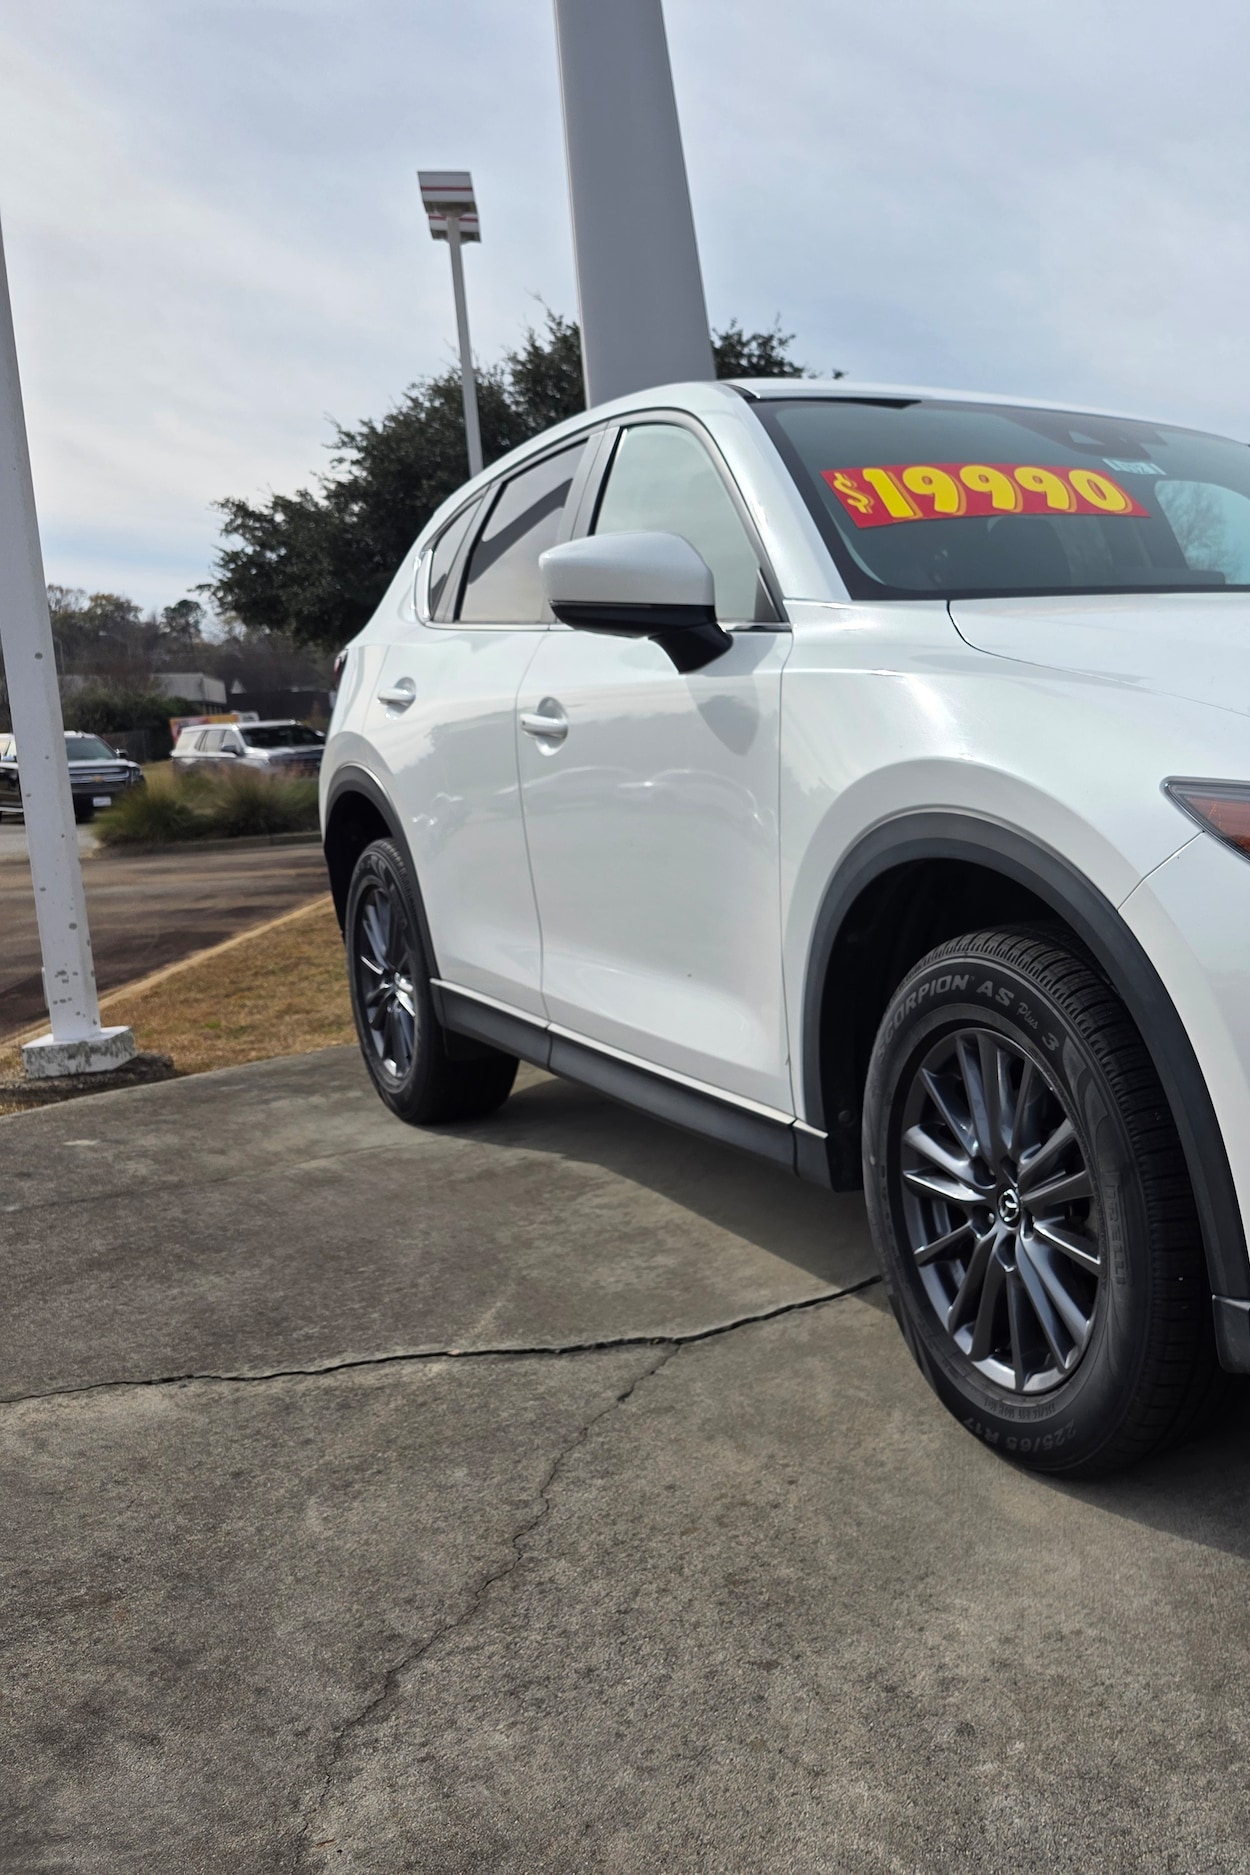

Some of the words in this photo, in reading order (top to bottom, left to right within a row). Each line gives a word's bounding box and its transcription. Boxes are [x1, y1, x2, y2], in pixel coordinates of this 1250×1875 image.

[833, 465, 1132, 519] $19990
[976, 980, 1015, 1008] AS
[1016, 1002, 1039, 1030] Plus
[1042, 1032, 1061, 1051] 3
